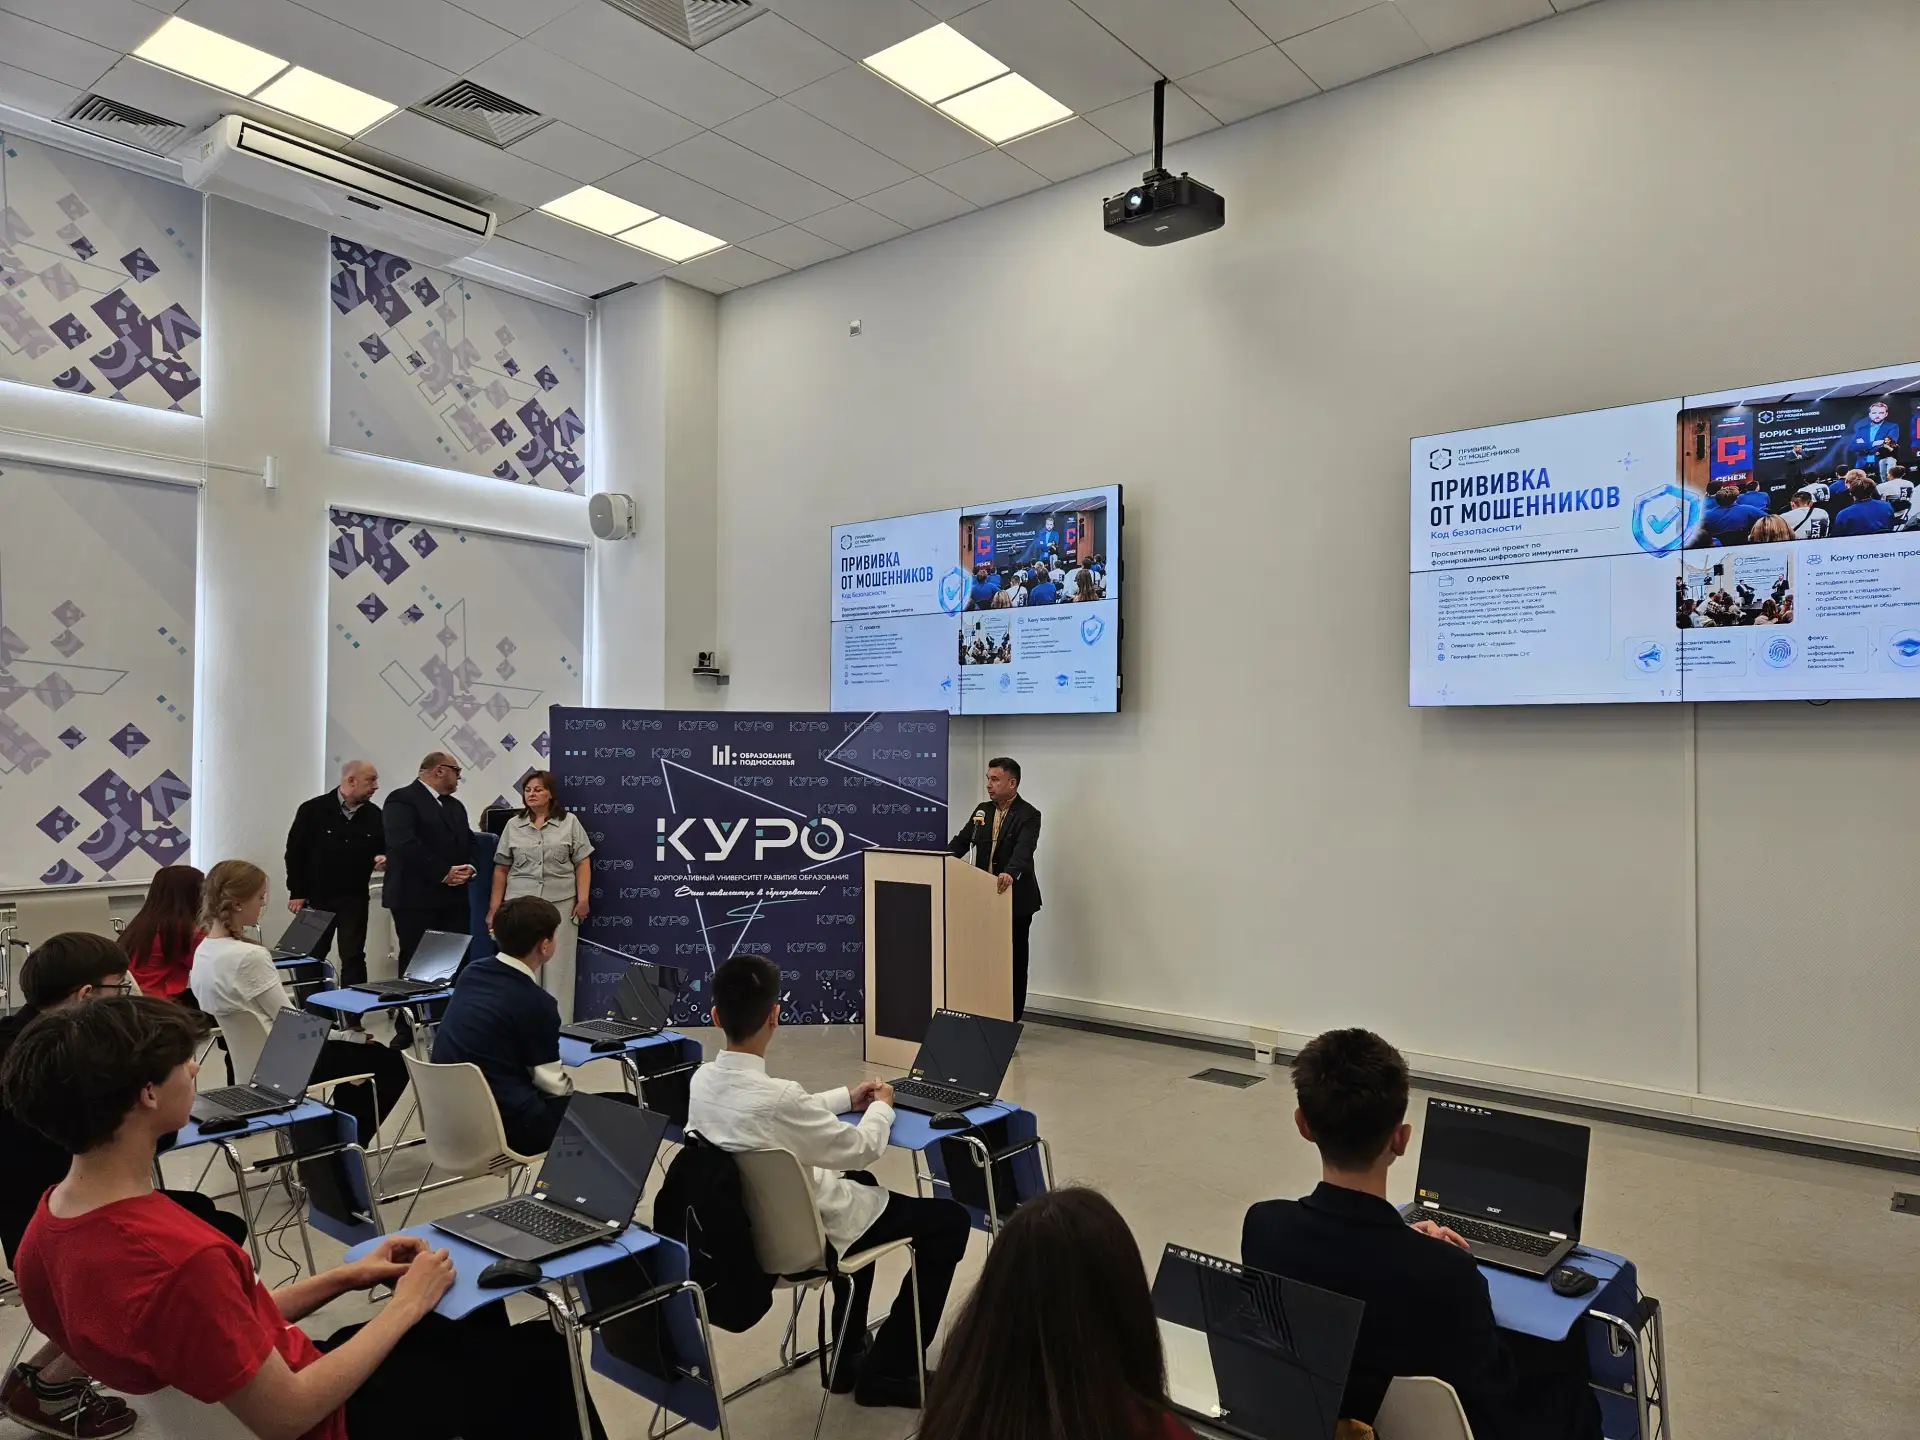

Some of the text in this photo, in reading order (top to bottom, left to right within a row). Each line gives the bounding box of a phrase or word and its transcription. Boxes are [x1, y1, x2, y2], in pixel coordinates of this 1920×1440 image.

[1760, 424, 1846, 439] БОРИС ЧЕРНЫШОВ
[1458, 444, 1497, 454] ПРИВИВКА
[1469, 448, 1520, 460] МОШЕННИКОВ
[1431, 468, 1550, 502] ПРИВИВКА
[1430, 486, 1620, 526] ОТ МОШЕННИКОВ
[1431, 524, 1522, 540] Код безопасности
[1432, 546, 1500, 558] Просветительский
[1502, 543, 1529, 552] проект
[842, 552, 900, 572] ПРИВИВКА
[1432, 547, 1578, 566] формированию цифрового иммунитета
[1830, 554, 1854, 562] Кому
[1857, 552, 1896, 560] полезен
[842, 566, 934, 590] ОТ МОШЕННИКОВ
[1476, 574, 1510, 584] проекте
[565, 720, 606, 730] КУРО
[622, 720, 662, 730] КУРО
[678, 720, 718, 732] КУРО
[734, 720, 774, 732] КУРО
[790, 721, 830, 732] КУРО
[898, 722, 936, 733] КУРО
[594, 748, 636, 758] КУРО
[652, 748, 692, 758] КУРО
[872, 748, 912, 760] КУРО
[565, 776, 606, 786] КУРО
[622, 776, 662, 786] КУРО
[734, 776, 774, 787] КУРО
[790, 776, 828, 787] КУРО
[898, 776, 937, 787] КУРО
[594, 804, 635, 814] КУРО
[818, 803, 857, 814] КУРО
[872, 803, 912, 814] КУРО
[656, 817, 844, 862] КУРО
[898, 832, 936, 842] КУРО
[593, 860, 634, 870] КУРО
[654, 874, 715, 882] КОРПОРАТИВНЫЙ
[620, 888, 660, 898] КУРО
[674, 884, 826, 898] Ваш навигатор в образовании!
[842, 886, 862, 897] КУ
[592, 916, 633, 926] КУРО
[648, 916, 690, 926] КУРО
[816, 914, 856, 925] КУРО
[618, 943, 660, 955] КУРО
[676, 943, 716, 954] КУРО
[786, 942, 827, 953] КУРО
[590, 972, 622, 984] КУР
[816, 970, 856, 980] КУРО
[1486, 1206, 1502, 1214] acer
